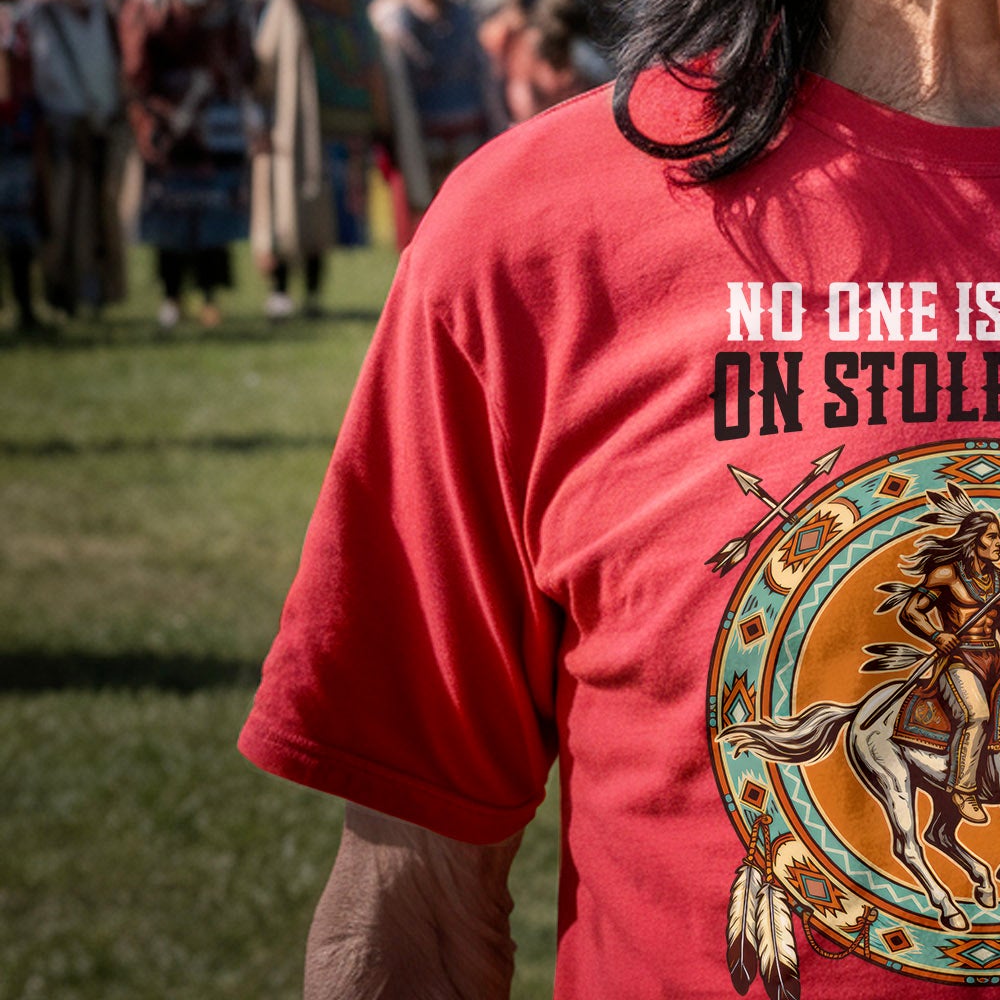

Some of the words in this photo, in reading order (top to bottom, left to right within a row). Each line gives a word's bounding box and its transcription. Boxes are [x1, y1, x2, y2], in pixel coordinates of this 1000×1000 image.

[726, 281, 807, 341] NO
[825, 281, 938, 341] ONE
[709, 351, 804, 442] ON
